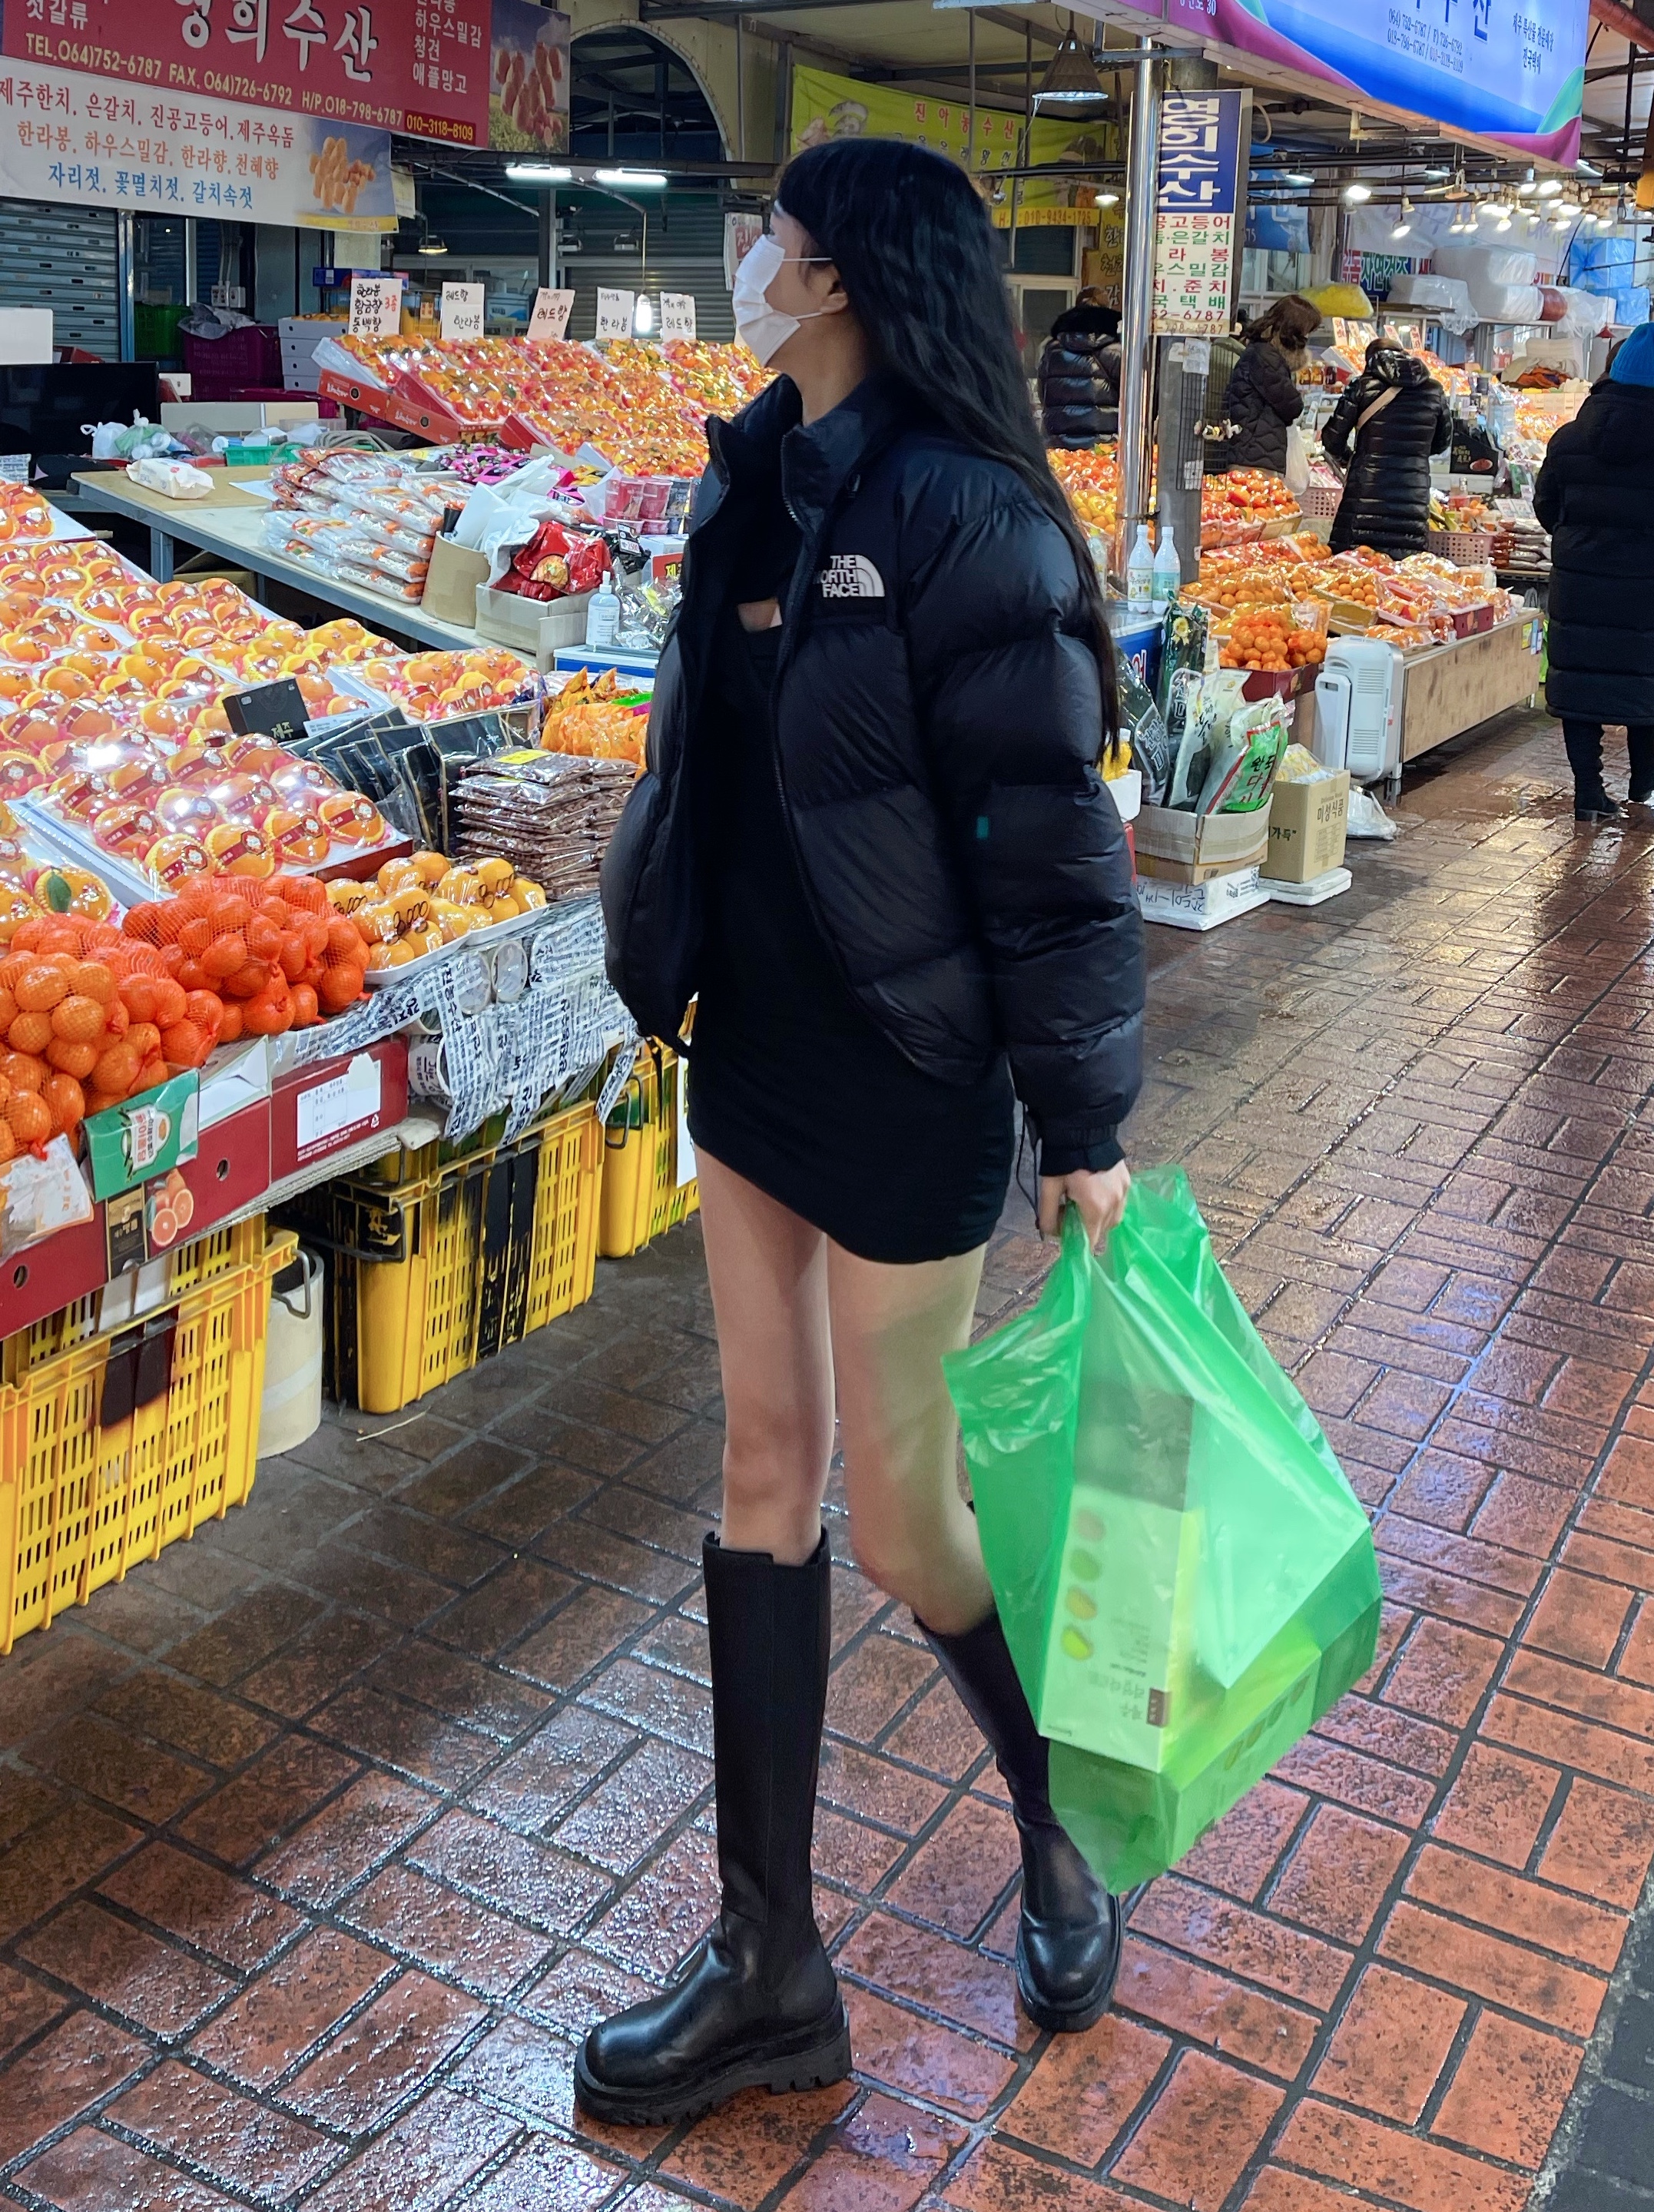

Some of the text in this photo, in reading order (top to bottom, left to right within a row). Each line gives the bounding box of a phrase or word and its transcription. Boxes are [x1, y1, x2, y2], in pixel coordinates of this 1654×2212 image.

[415, 9, 482, 49] 하우스밀감
[414, 35, 440, 62] 청견
[413, 63, 467, 95] 애플망고
[406, 114, 473, 141] 010-3118-8109
[1158, 98, 1221, 207] 영희수산
[192, 180, 253, 211] 갈치속젓
[453, 314, 480, 330] 한라봉
[537, 304, 568, 322] 레드향
[600, 316, 628, 332] 한라봉
[830, 555, 857, 569] THE
[822, 583, 860, 598] FACE
[270, 721, 293, 739] 제주
[1317, 798, 1344, 824] 미성식품
